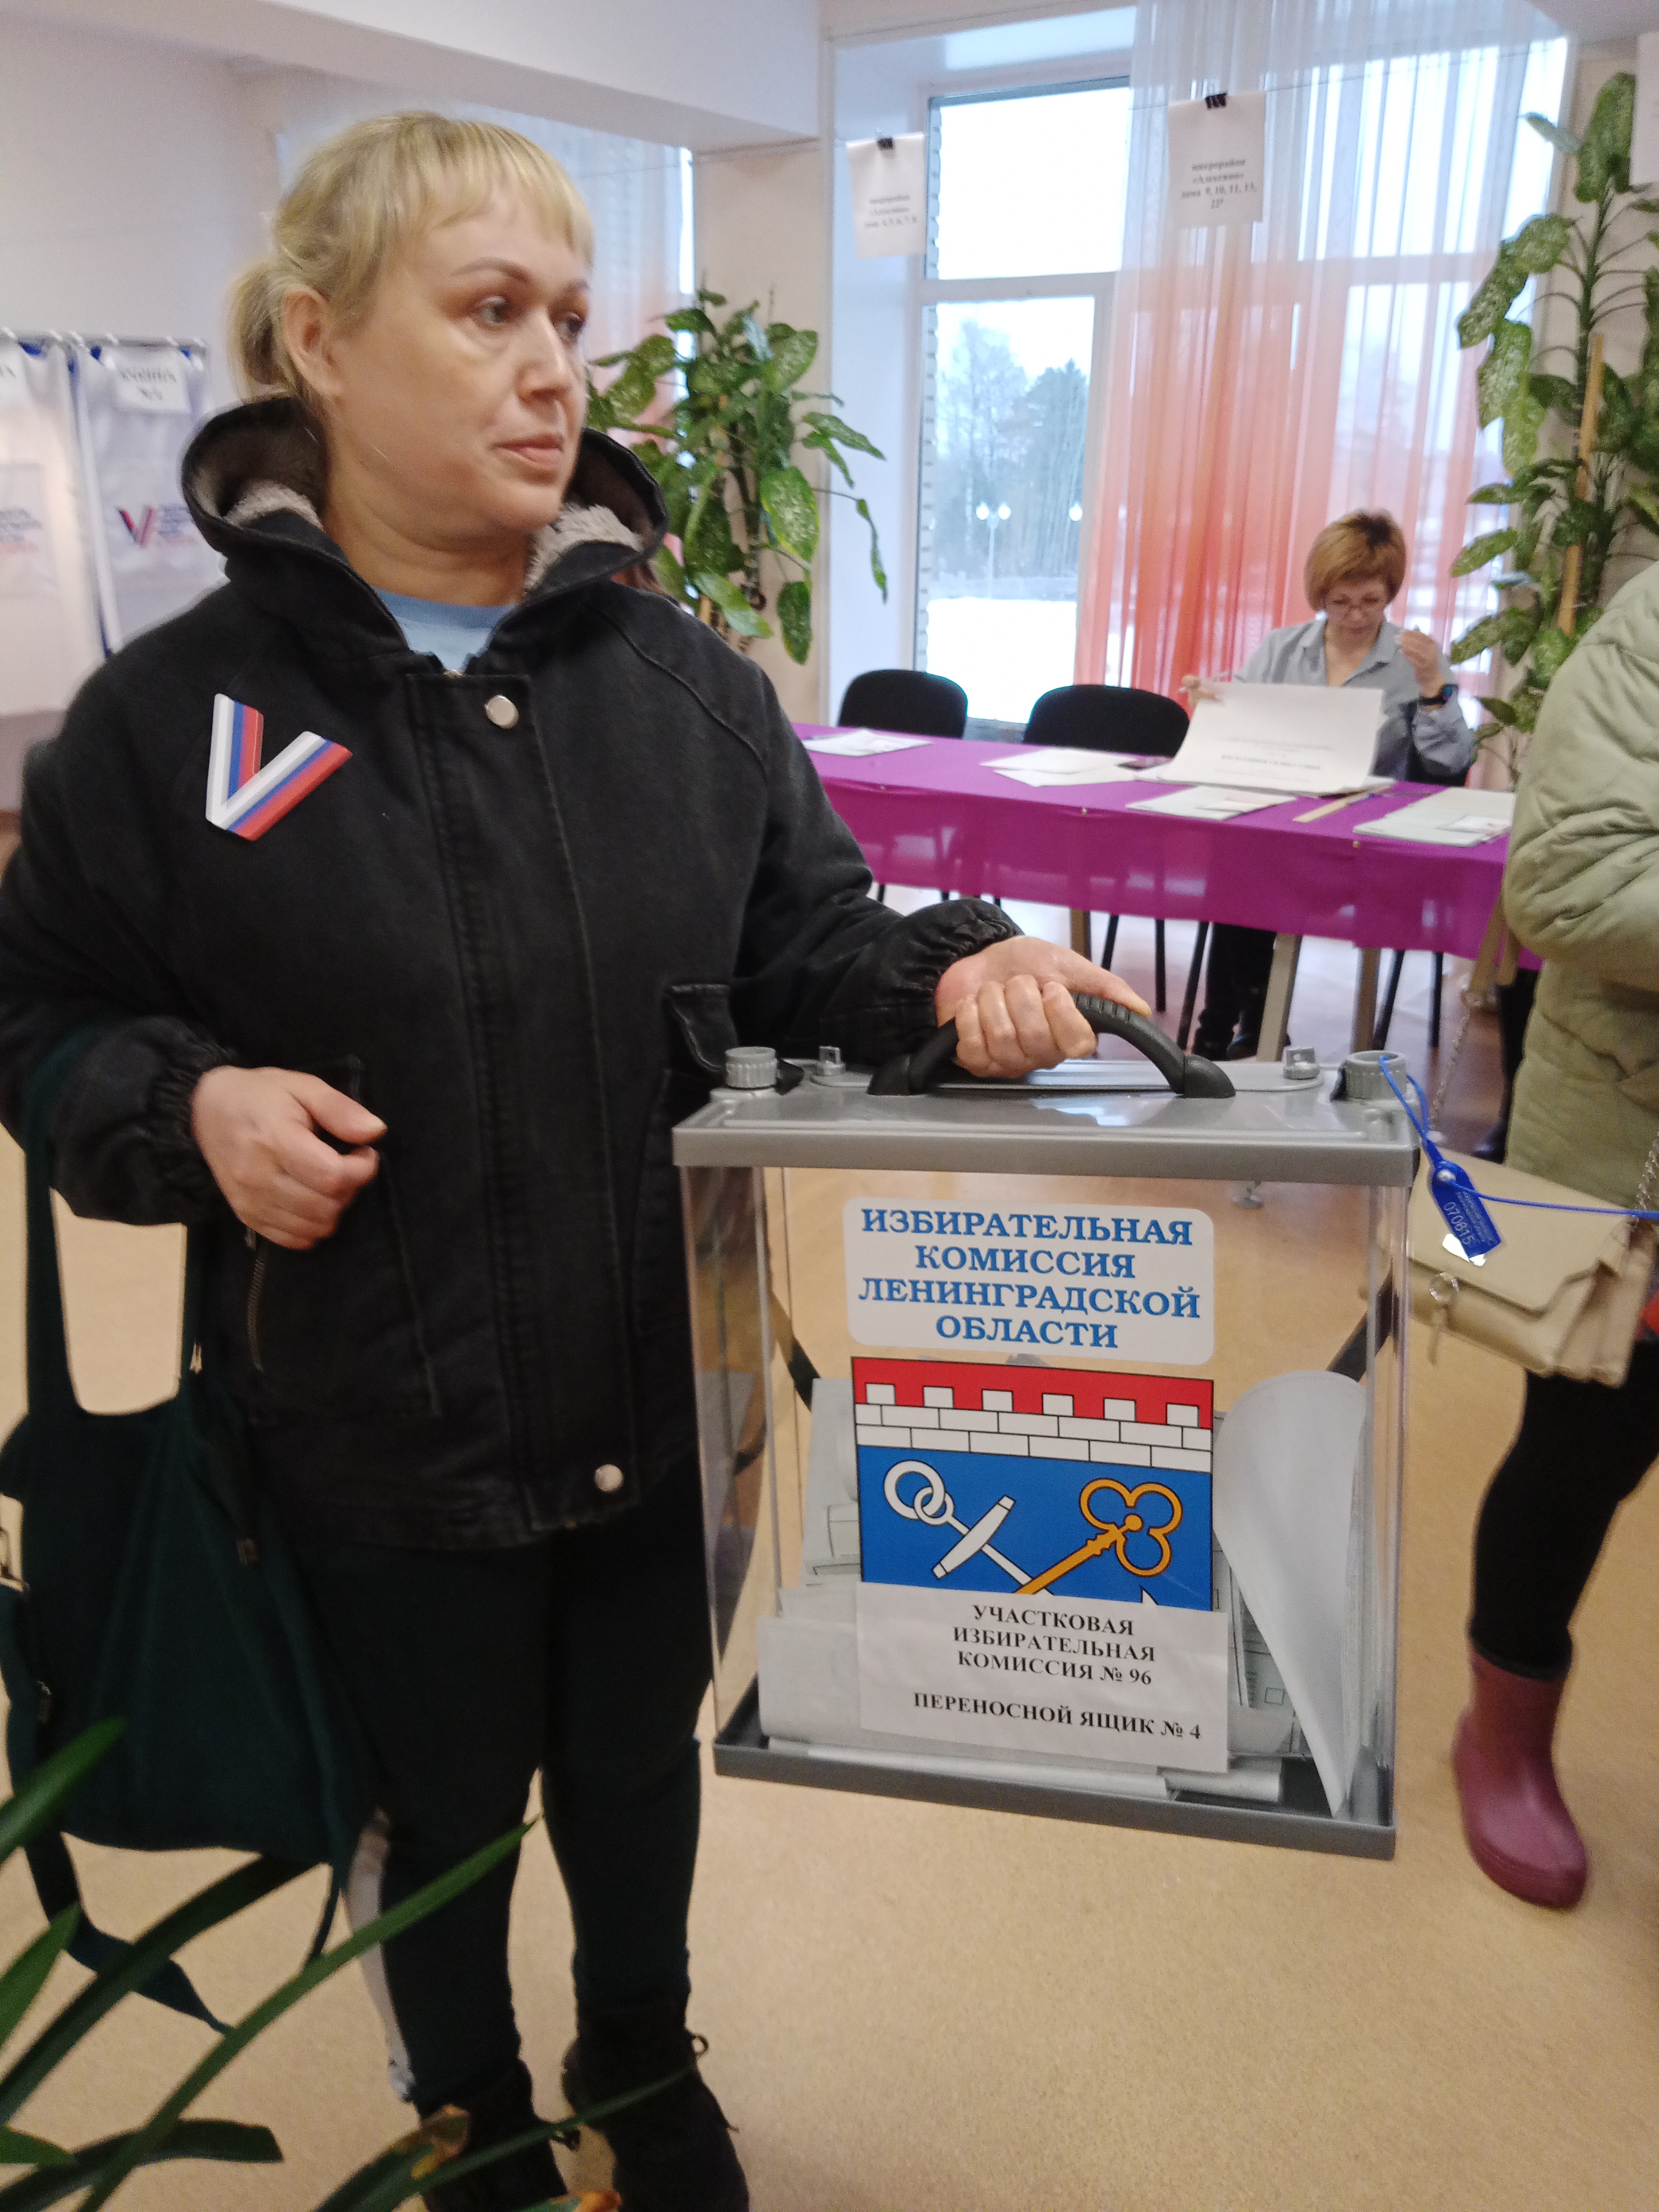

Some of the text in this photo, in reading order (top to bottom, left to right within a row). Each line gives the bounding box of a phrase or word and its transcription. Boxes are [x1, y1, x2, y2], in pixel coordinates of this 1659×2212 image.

[861, 1208, 1193, 1246] ИЗБИРАТЕЛЬНАЯ
[1443, 1202, 1475, 1245] 070815
[914, 1245, 1136, 1279] КОМИССИЯ
[858, 1277, 1201, 1319] ЛЕНИНГРАДСКОЙ
[936, 1315, 1118, 1349] ОБЛАСТИ
[972, 1604, 1134, 1636] УЧАСТКОВАЯ
[953, 1626, 1155, 1662] ИЗБИРАТЕЛЬНАЯ
[957, 1650, 1152, 1685] КОМИССИЯ № 96
[913, 1692, 1201, 1740] ПЕРЕНОСНОЙ ЯЩИК № 4
